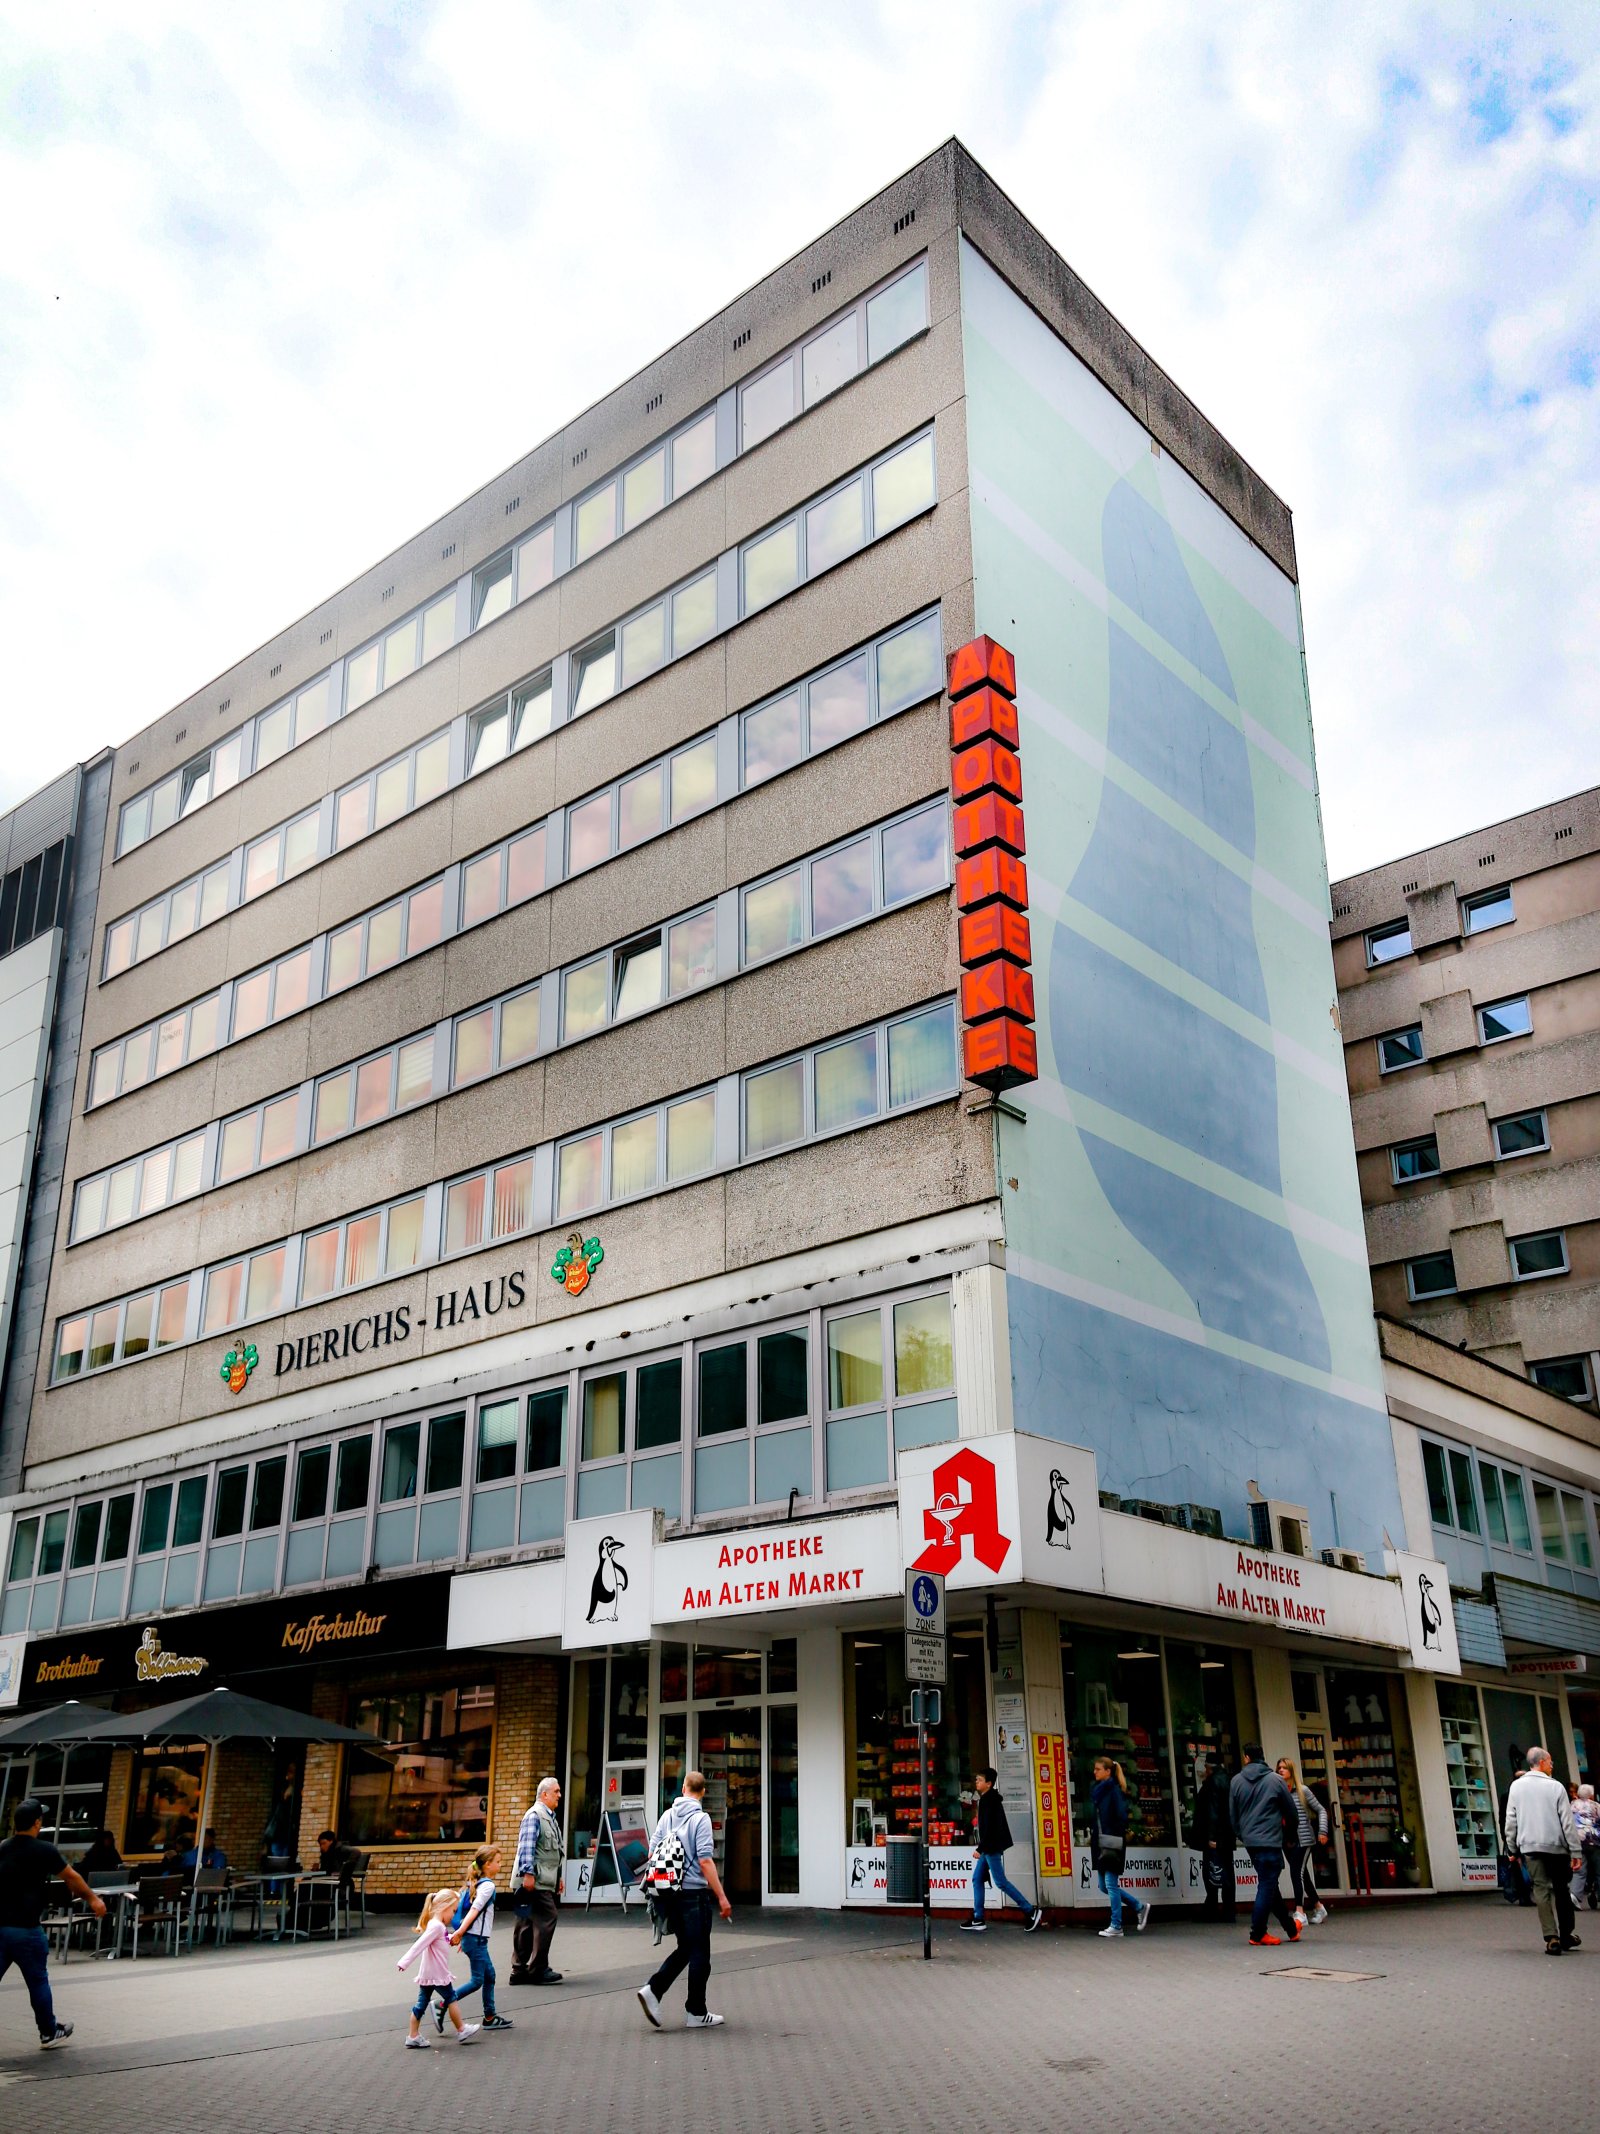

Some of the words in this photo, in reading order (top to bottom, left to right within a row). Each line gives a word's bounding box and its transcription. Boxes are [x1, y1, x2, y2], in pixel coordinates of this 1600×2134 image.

[951, 647, 1005, 1074] APOTHEKE
[988, 645, 1037, 1075] APOTHEKE
[718, 1536, 824, 1568] APOTHEKE
[1236, 1552, 1302, 1588] APOTHEKE
[681, 1586, 713, 1611] AM
[718, 1580, 780, 1606] ALTEN
[788, 1568, 864, 1597] MARKT
[1216, 1583, 1238, 1608] AM
[1241, 1588, 1281, 1617] ALTEN
[1283, 1602, 1326, 1626] MARKT
[281, 1610, 387, 1653] Kaffeekultur
[915, 1617, 936, 1631] ZONE
[36, 1653, 104, 1683] Brotkultur
[1511, 1660, 1578, 1673] APOTHEKE
[1055, 1747, 1069, 1863] TELEWELT
[929, 1860, 972, 1871] OTHEKE
[1125, 1859, 1163, 1870] APOTHEKE
[1236, 1875, 1258, 1885] MARKT
[928, 1878, 968, 1889] MARKT
[1135, 1877, 1160, 1888] MARKT
